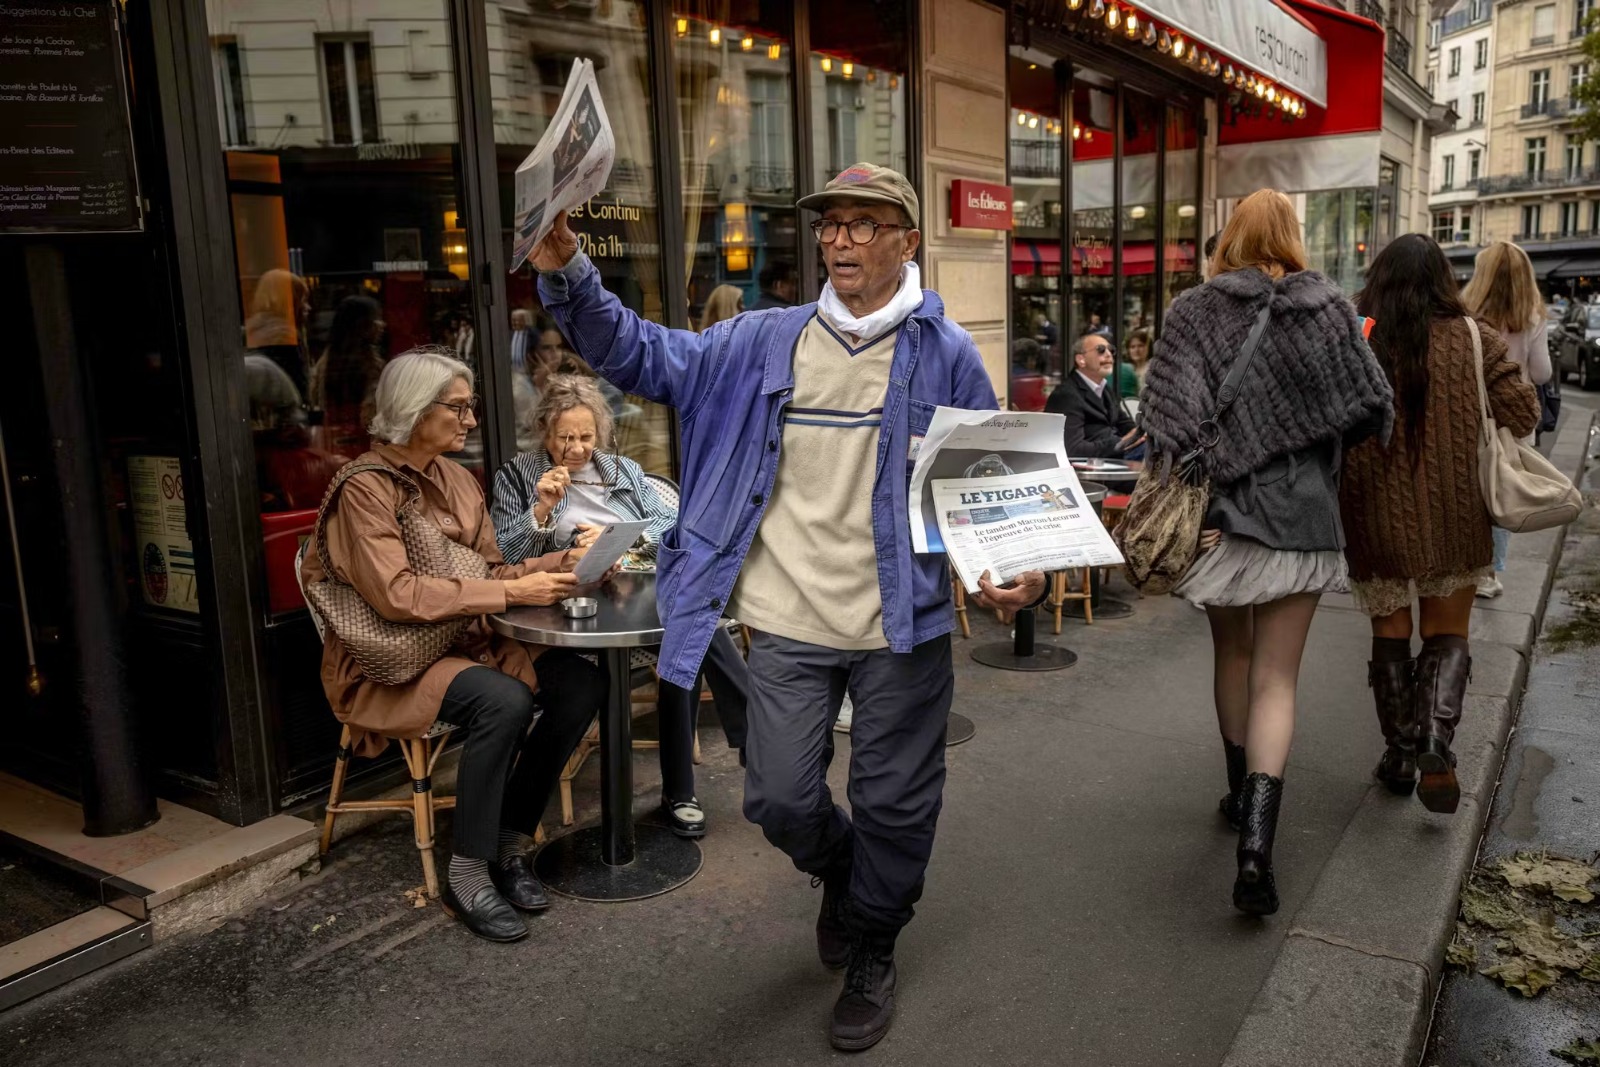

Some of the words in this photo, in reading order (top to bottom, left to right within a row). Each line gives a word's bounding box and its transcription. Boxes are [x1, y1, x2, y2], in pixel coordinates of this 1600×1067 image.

[59, 7, 71, 17] du
[74, 7, 96, 17] Chef
[2, 35, 12, 43] de
[14, 36, 32, 44] Joue
[33, 36, 44, 44] de
[45, 36, 75, 45] Cochon
[1256, 26, 1308, 80] restaurant
[28, 83, 39, 91] de
[40, 82, 60, 91] Poulet
[70, 83, 77, 91] la
[26, 93, 37, 102] Riz
[38, 93, 68, 102] Basmati
[69, 94, 76, 102] &
[78, 94, 104, 102] Tortillas
[24, 184, 44, 192] Sainte
[46, 184, 81, 193] Marguerite
[588, 193, 639, 221] Continu
[980, 190, 1007, 211] Éditeurs
[598, 236, 607, 256] à
[608, 235, 623, 257] 1h
[991, 419, 1002, 427] New
[1003, 420, 1014, 430] York
[1014, 420, 1028, 428] Times
[960, 492, 982, 504] LE
[984, 483, 1051, 503] FIGARO
[974, 529, 985, 537] Le
[985, 523, 1017, 535] tandem
[984, 529, 1022, 543] l'épreuve
[1023, 525, 1033, 533] de
[1043, 522, 1062, 530] crise
